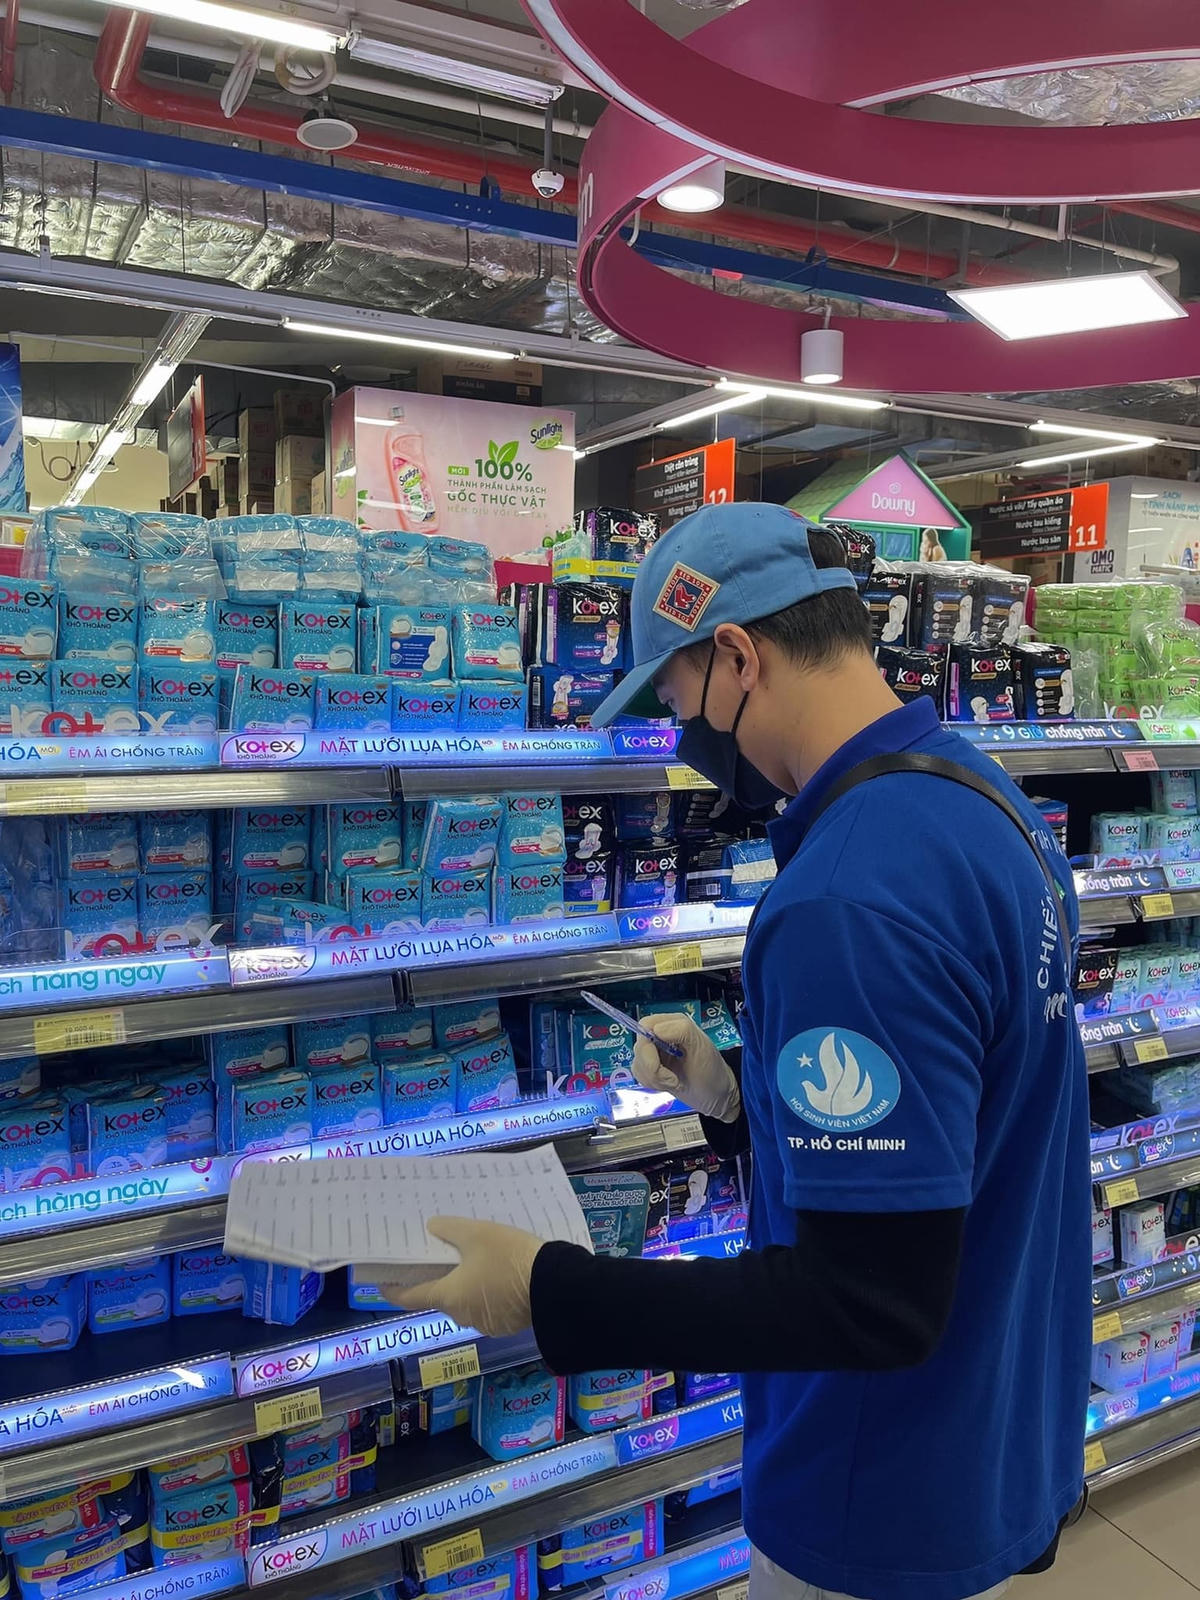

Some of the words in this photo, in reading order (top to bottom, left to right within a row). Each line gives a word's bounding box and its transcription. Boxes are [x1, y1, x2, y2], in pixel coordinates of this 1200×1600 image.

[530, 422, 563, 445] Sunlight
[475, 459, 533, 482] 100%
[481, 493, 517, 507] THỰC
[521, 495, 547, 509] VẬT
[871, 492, 916, 516] Downy
[610, 518, 657, 540] kotex
[1075, 524, 1099, 547] 11
[1091, 549, 1115, 564] OMO
[66, 604, 135, 624] kotex
[572, 597, 619, 616] kotex
[219, 609, 278, 631] kotex
[293, 609, 351, 630] kotex
[971, 658, 1011, 672] kotex
[59, 669, 132, 690] kotex
[150, 676, 216, 698] kotex
[250, 674, 313, 698] kotex
[896, 667, 939, 687] kotex
[327, 687, 388, 707] kotex
[398, 695, 456, 714] kotex
[468, 694, 521, 712] kotex
[622, 732, 670, 748] kotex
[1002, 724, 1015, 739] 9
[1046, 723, 1084, 741] chống
[1084, 724, 1107, 738] tràn
[69, 748, 91, 759] ÊM
[94, 746, 107, 758] ÁI
[111, 743, 165, 758] CHỐNG
[167, 746, 204, 757] TRÀN
[235, 737, 297, 755] kotex
[320, 738, 361, 756] MẶT
[363, 735, 406, 753] LƯỚI
[411, 738, 442, 756] LỤA
[448, 735, 482, 752] HÓA
[502, 740, 518, 751] ÊM
[520, 739, 531, 750] ÁI
[532, 736, 573, 751] CHỐNG
[575, 738, 601, 750] TRÀN
[343, 802, 399, 824] kotex
[507, 796, 557, 812] kotex
[247, 811, 306, 827] kotex
[448, 816, 499, 834] kotex
[1107, 824, 1138, 836] kotex
[1168, 827, 1192, 840] kotex
[636, 857, 678, 876] kotex
[146, 882, 208, 899] kotex
[246, 880, 306, 896] kotex
[431, 877, 487, 893] kotex
[510, 872, 562, 890] kotex
[1109, 873, 1133, 888] tràn
[68, 886, 135, 905] kotex
[361, 887, 420, 906] kotex
[290, 907, 328, 922] kotex
[628, 911, 673, 931] kotex
[513, 932, 530, 945] ÊM
[532, 929, 542, 943] ÁI
[543, 924, 582, 942] CHỐNG
[332, 946, 372, 968] MẶT
[375, 942, 419, 962] LƯỚI
[421, 939, 454, 957] LỤA
[458, 932, 496, 951] HÓA
[1078, 966, 1115, 983] kotex
[1147, 965, 1172, 978] kotex
[583, 1022, 630, 1039] kotex
[1101, 1020, 1124, 1037] tràn
[461, 1047, 511, 1074] kotex
[315, 1078, 376, 1101] kotex
[395, 1074, 451, 1096] kotex
[244, 1093, 307, 1116] kotex
[803, 1109, 826, 1125] SINH
[827, 1118, 850, 1128] VIÊN
[873, 1099, 890, 1117] NAM
[104, 1102, 167, 1132] kotex
[503, 1117, 520, 1132] ÊM
[522, 1114, 532, 1128] ÁI
[533, 1104, 573, 1125] CHỐNG
[367, 1132, 411, 1154] LƯỚI
[413, 1129, 446, 1149] LỤA
[449, 1120, 486, 1142] HÓA
[787, 1136, 808, 1149] TP.
[810, 1134, 833, 1150] HỒ
[836, 1136, 863, 1151] CHÍ
[866, 1139, 906, 1151] MINH
[36, 1187, 101, 1216] hàng
[107, 1177, 169, 1206] ngày
[1142, 1215, 1164, 1231] kotex
[334, 1337, 373, 1362] MẶT
[376, 1324, 419, 1352] LƯỚI
[422, 1319, 454, 1343] LỤA
[1154, 1335, 1178, 1349] kotex
[252, 1351, 313, 1381] kotex
[590, 1369, 638, 1391] kotex
[88, 1402, 110, 1417] ÊM
[128, 1382, 181, 1407] CHỐNG
[503, 1388, 551, 1412] kotex
[16, 1405, 64, 1433] HÓA
[629, 1426, 675, 1450] kotex
[512, 1475, 530, 1491] ÊM
[530, 1470, 541, 1485] ÁI
[540, 1459, 580, 1482] CHỐNG
[165, 1500, 231, 1525] kotex
[341, 1522, 378, 1549] MẶT
[381, 1508, 423, 1536] LƯỚI
[425, 1496, 457, 1521] LỤA
[459, 1483, 496, 1508] HÓA
[584, 1513, 631, 1539] kotex
[262, 1541, 320, 1569] kotex
[144, 1574, 196, 1600] CHỐNG
[197, 1566, 231, 1585] TRÀN
